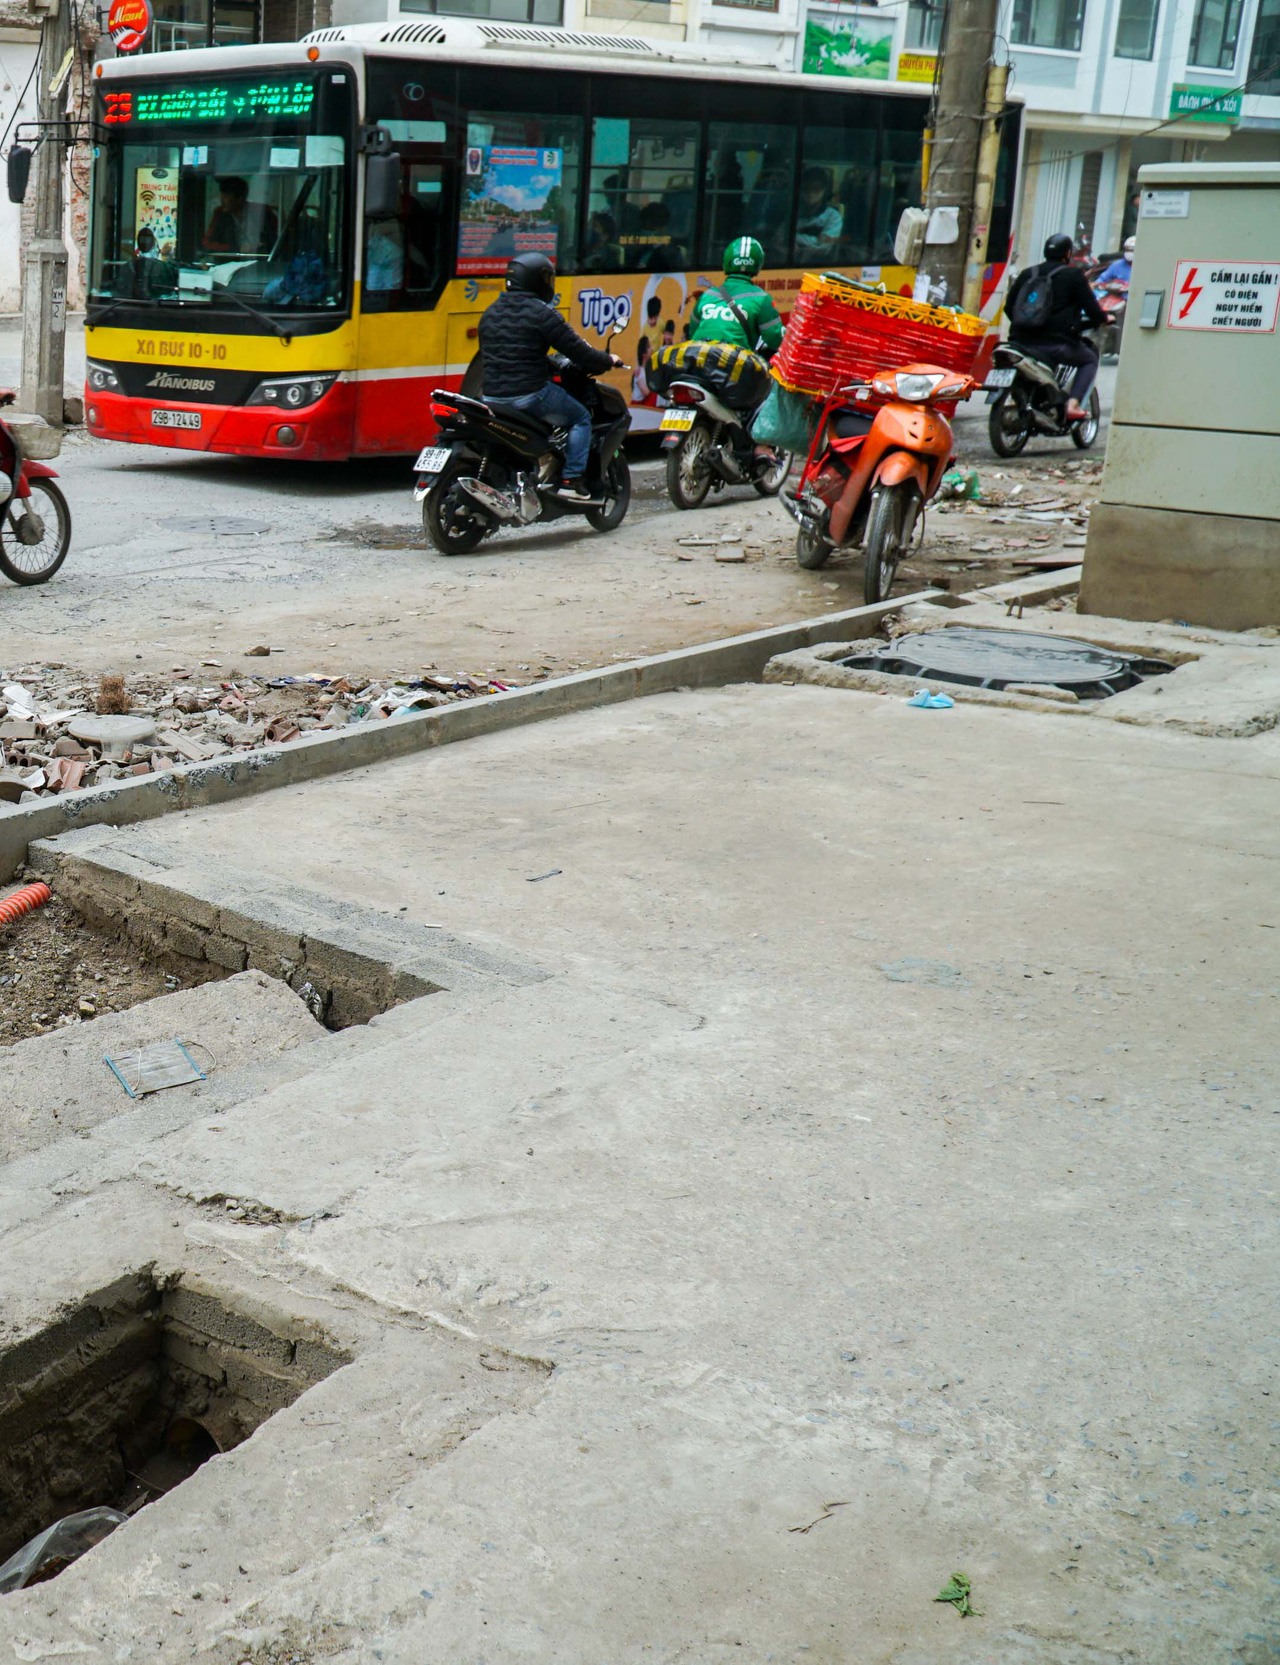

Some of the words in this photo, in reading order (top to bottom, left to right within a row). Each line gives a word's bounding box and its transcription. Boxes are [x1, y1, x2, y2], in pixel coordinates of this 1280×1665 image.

[734, 258, 755, 266] Grab
[579, 288, 630, 335] Tipo
[702, 303, 748, 323] Grab
[1216, 304, 1238, 312] NGUY
